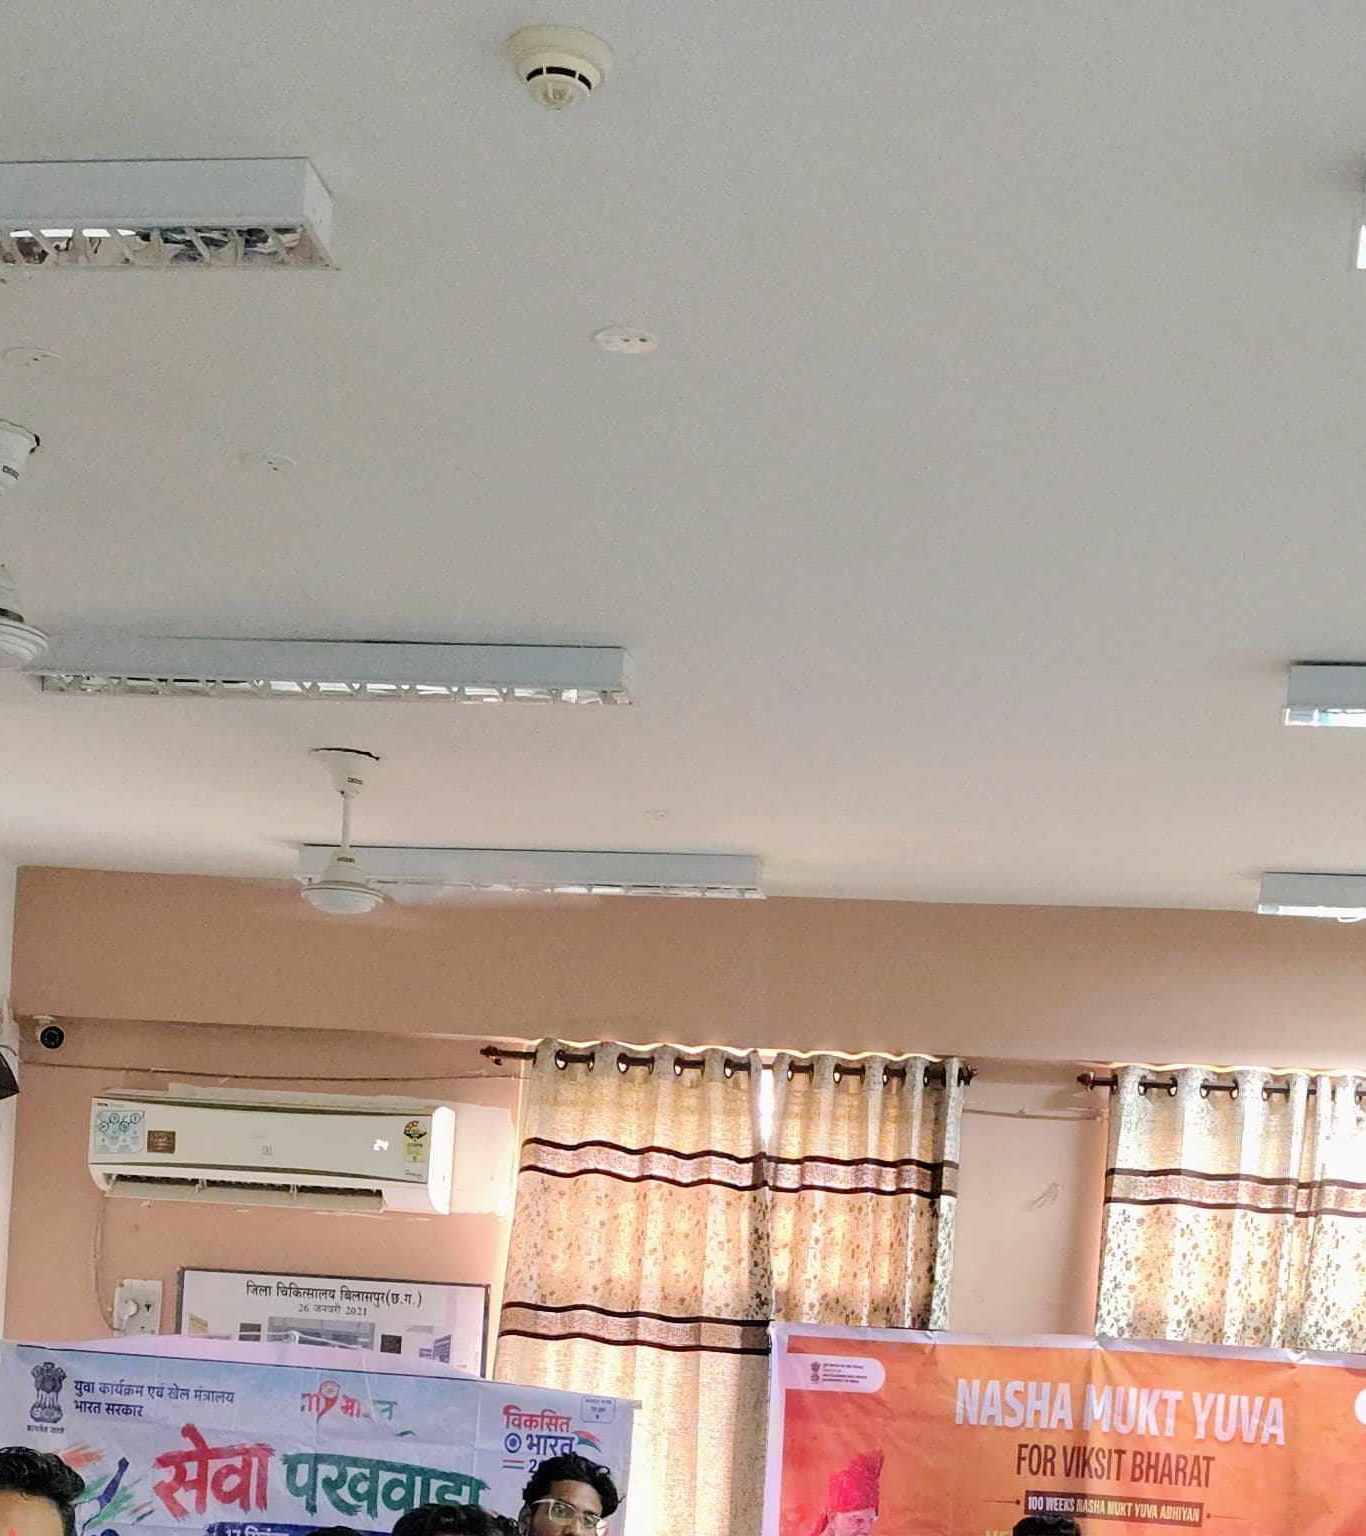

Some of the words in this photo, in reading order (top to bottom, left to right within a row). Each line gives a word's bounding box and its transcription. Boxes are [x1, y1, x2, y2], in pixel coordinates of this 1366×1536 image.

[246, 1280, 272, 1297] जिला
[276, 1281, 336, 1301] चिकित्सालय
[298, 1303, 310, 1313] 26
[345, 1306, 368, 1317] 2021
[73, 1380, 95, 1397] युवा
[98, 1379, 144, 1398] कार्यक्रम
[147, 1383, 165, 1399] एवं
[168, 1383, 190, 1400] खेल
[193, 1385, 235, 1404] मंत्रालय
[73, 1400, 102, 1415] भारत
[105, 1403, 144, 1417] सरकार
[502, 1404, 572, 1433] विकसित
[955, 1378, 1074, 1431] NASHA
[1083, 1384, 1184, 1437] MUKT
[1192, 1391, 1286, 1446] YUVA
[524, 1433, 575, 1457] भारत
[152, 1422, 276, 1522] सेवा
[1016, 1443, 1057, 1477] FOR
[1063, 1445, 1127, 1483] VIKSIT
[1131, 1450, 1216, 1488] BHARAT
[1028, 1496, 1044, 1510] 100
[1045, 1497, 1076, 1513] WEEKS
[1076, 1499, 1105, 1515] NASHA
[1107, 1501, 1135, 1518] MUKT
[1134, 1503, 1158, 1520] YUVA
[1159, 1505, 1201, 1523] ABHIYAN
